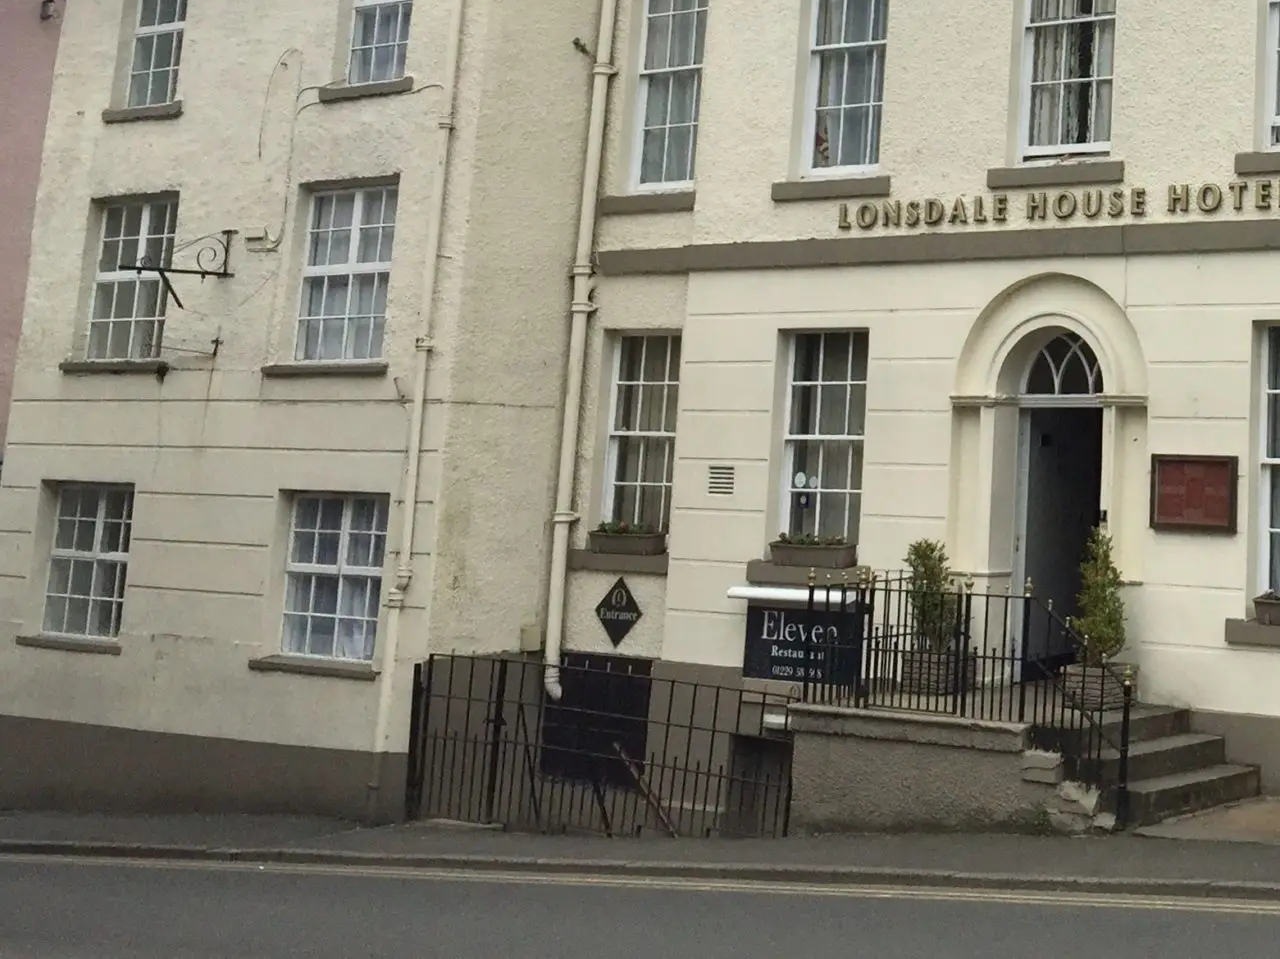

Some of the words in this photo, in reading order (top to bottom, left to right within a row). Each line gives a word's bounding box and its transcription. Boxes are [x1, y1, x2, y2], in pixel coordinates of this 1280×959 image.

[838, 192, 1008, 230] LONSDALE
[1026, 186, 1146, 220] HOUSE
[600, 607, 638, 621] Entrance
